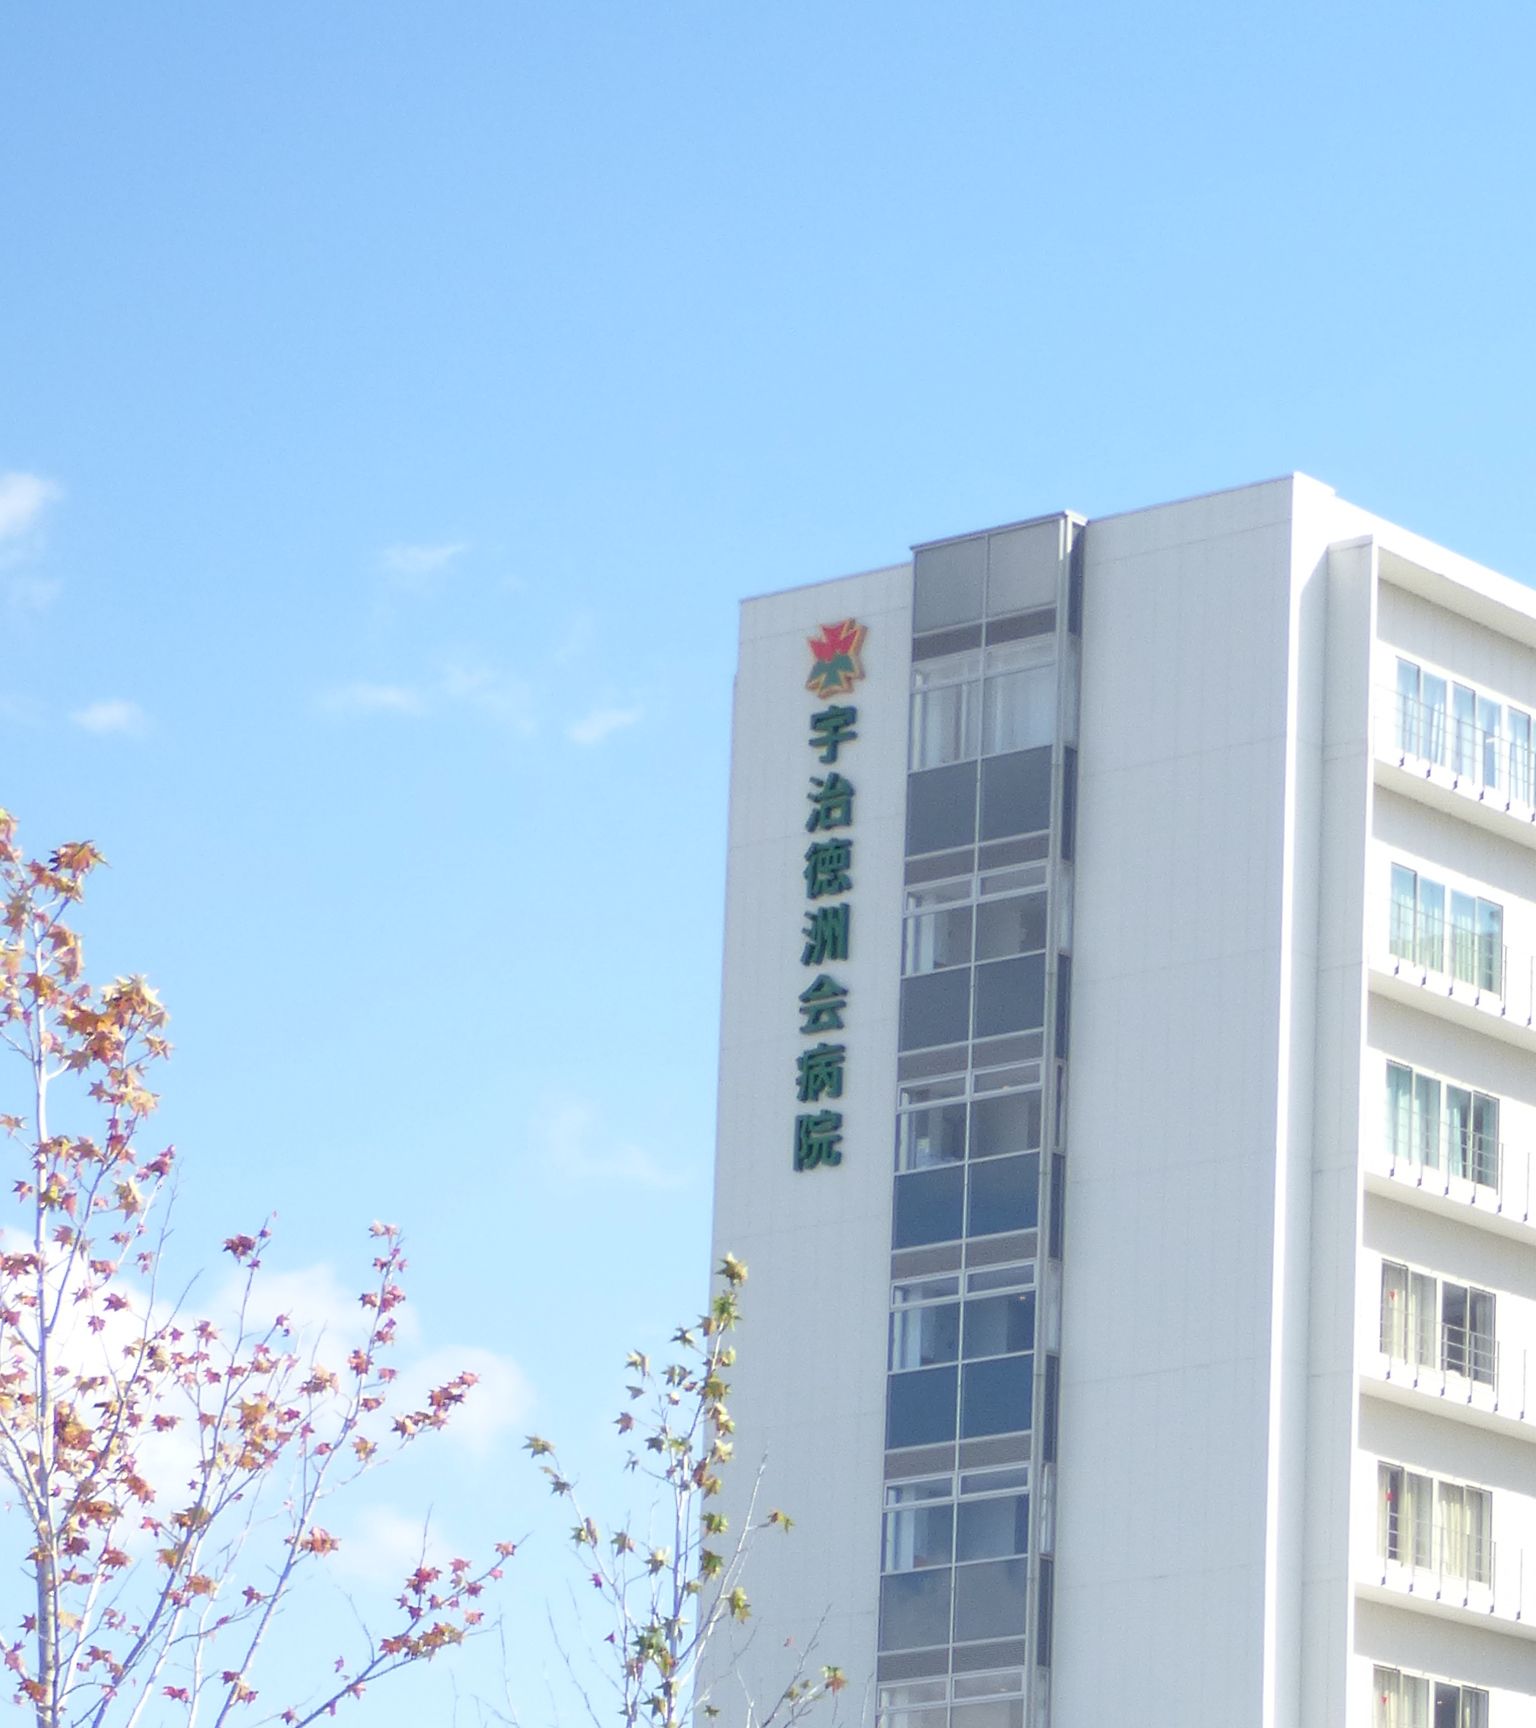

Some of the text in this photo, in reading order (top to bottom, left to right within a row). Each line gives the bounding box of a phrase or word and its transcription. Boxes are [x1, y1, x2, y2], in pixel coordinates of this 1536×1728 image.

[793, 705, 859, 1172] 宇治徳洲会病院
